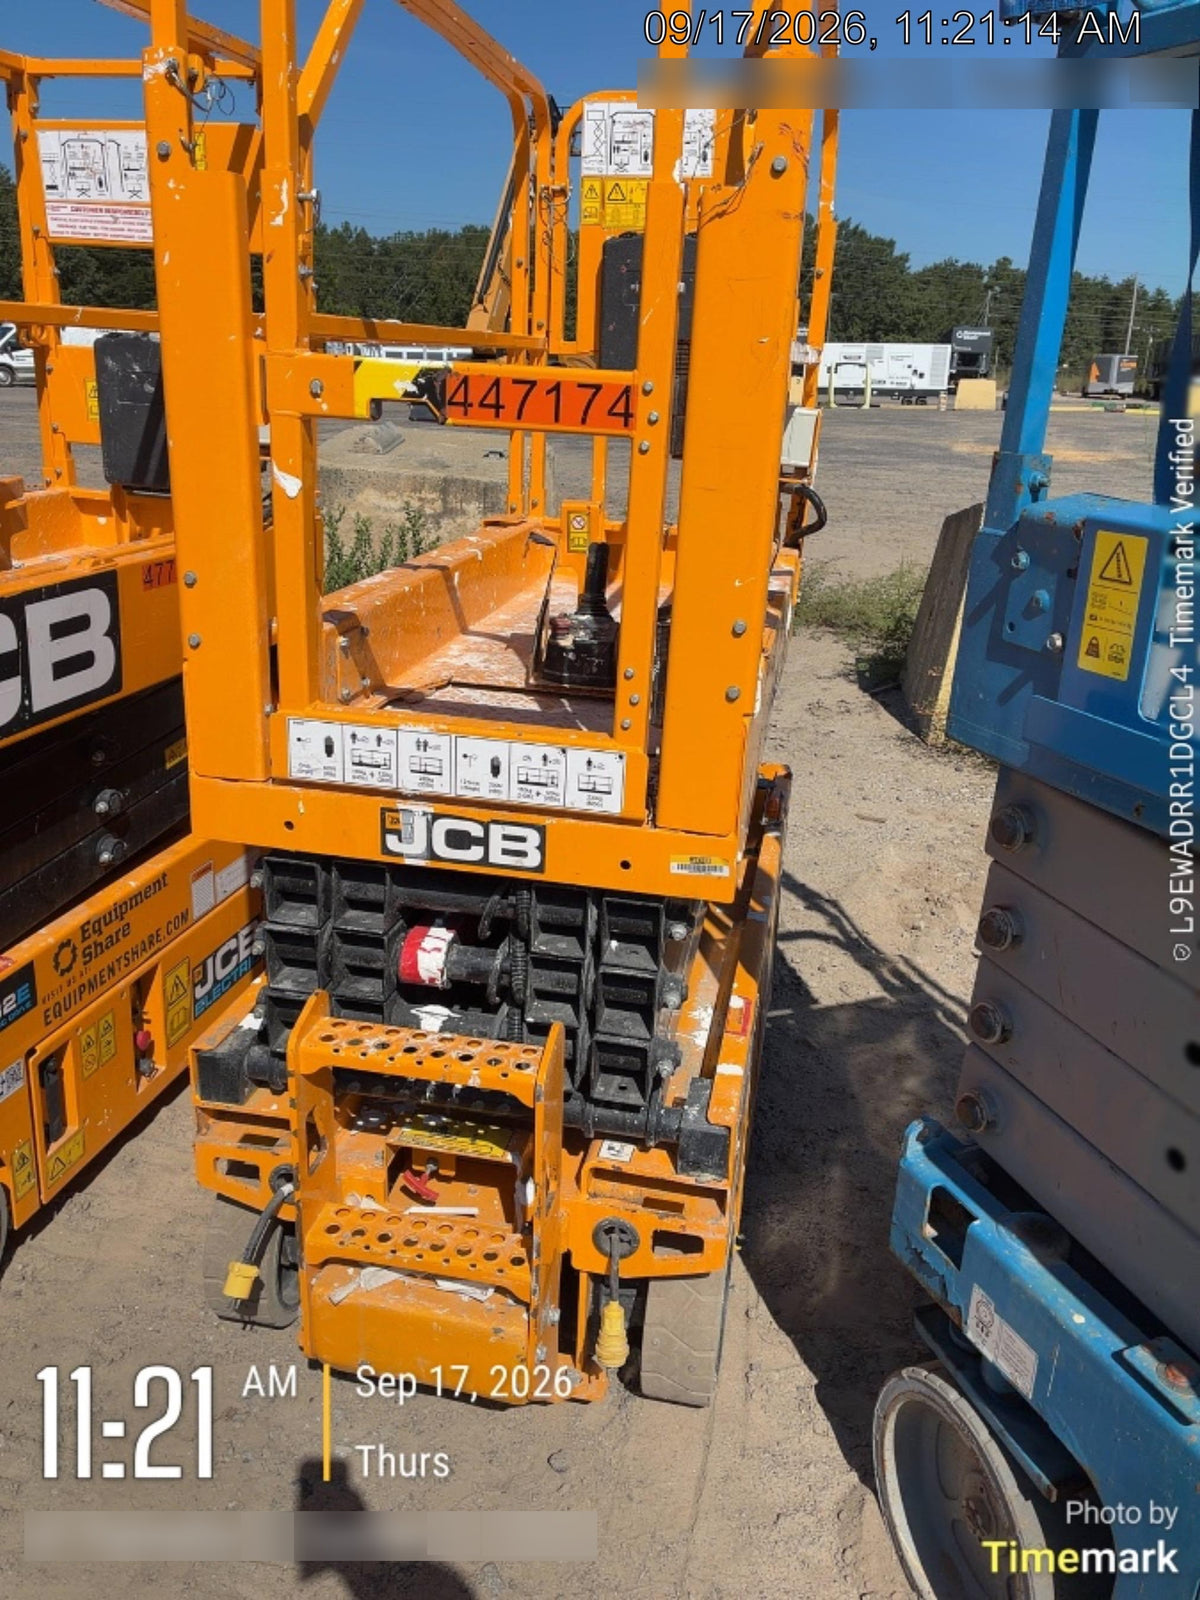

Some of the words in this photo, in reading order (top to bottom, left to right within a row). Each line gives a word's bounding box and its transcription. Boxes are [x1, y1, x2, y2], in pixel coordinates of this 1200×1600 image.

[447, 374, 635, 428] 447174
[385, 811, 543, 869] JCB
[80, 871, 169, 943] Equipment
[43, 907, 190, 1027] EQUIPMENTSHARE.COM
[81, 921, 131, 967] Share
[0, 981, 31, 1018] 2E
[195, 956, 252, 1018] ELECTRI
